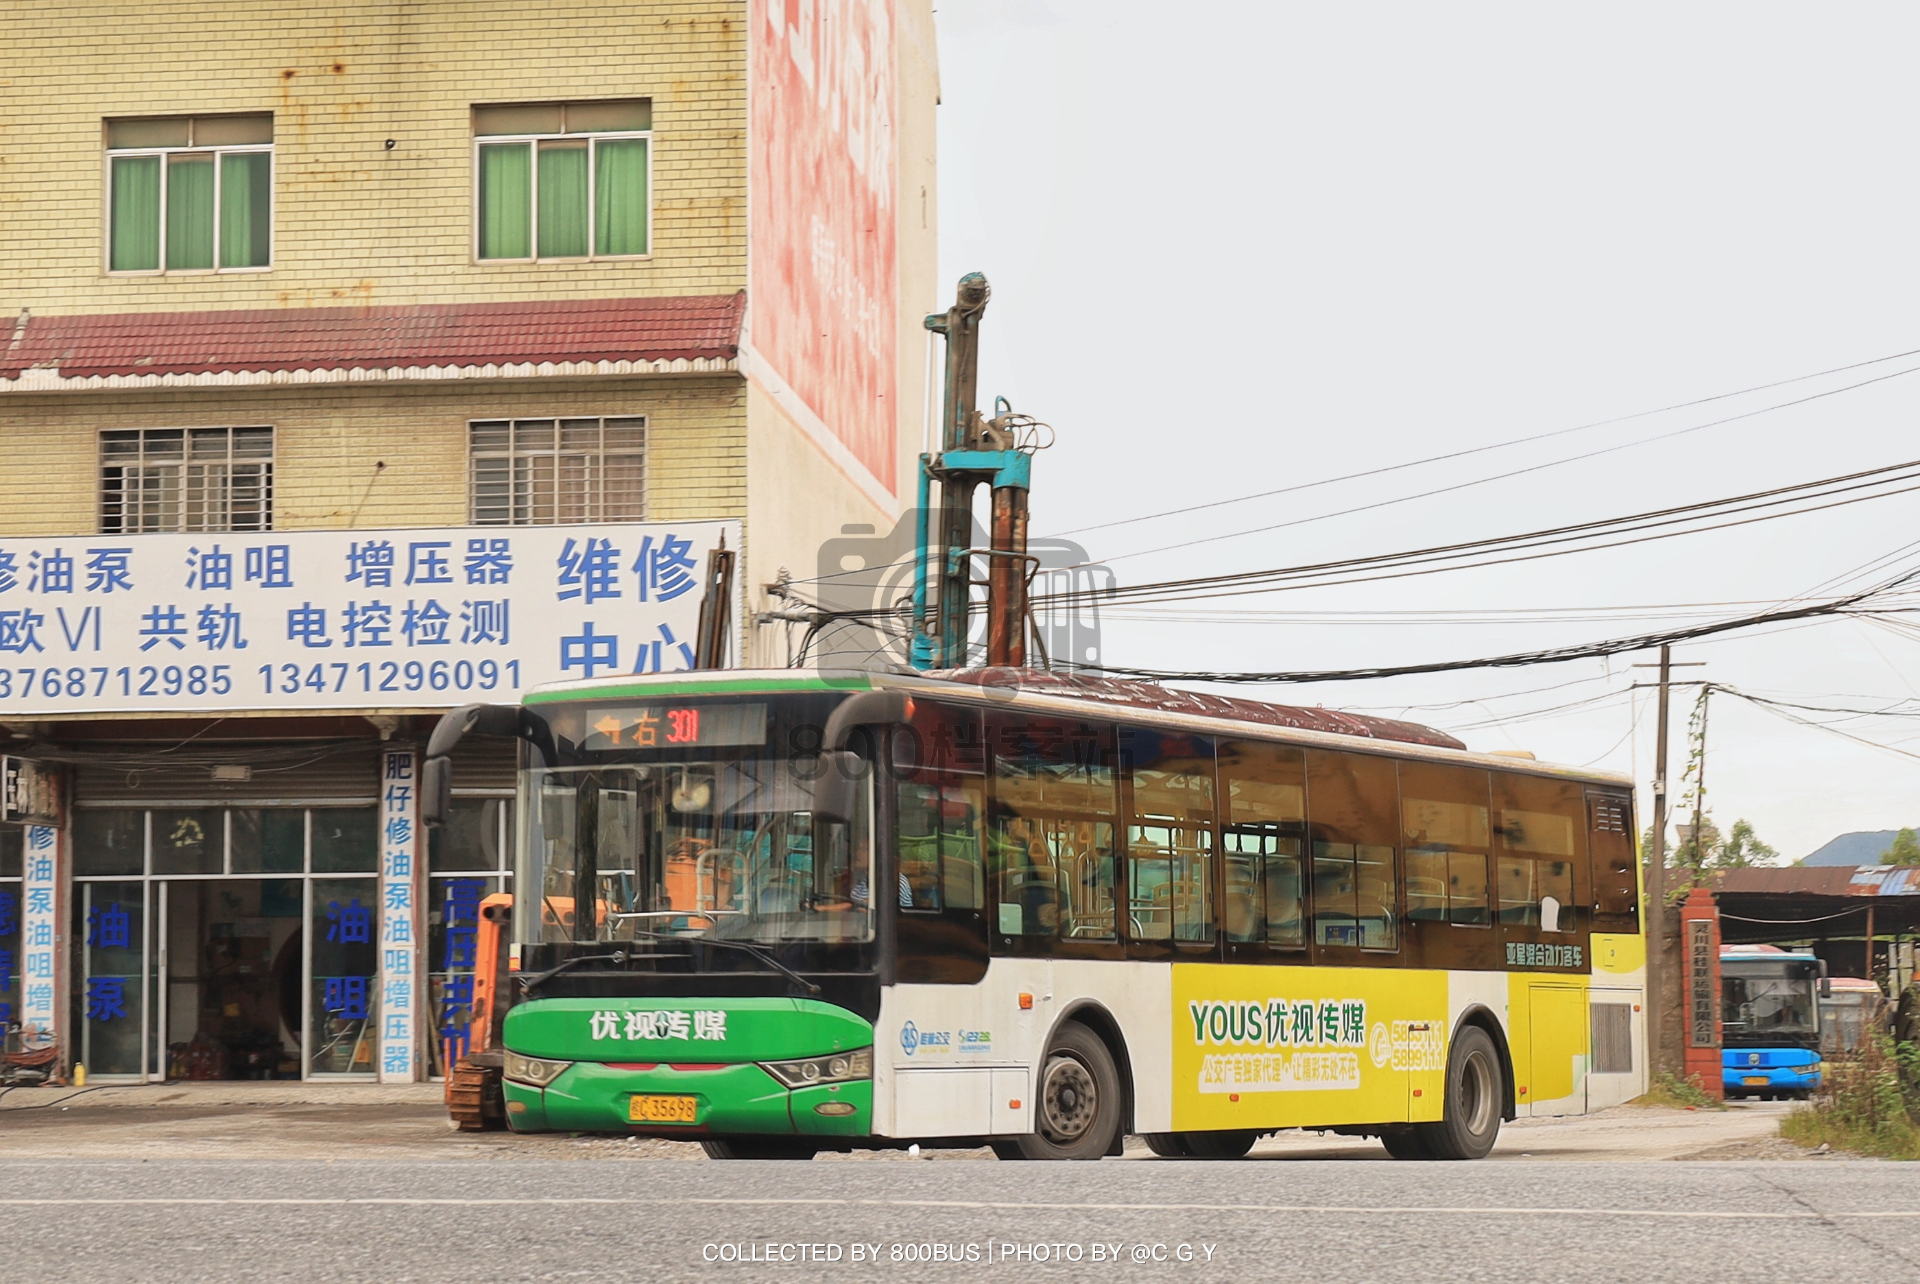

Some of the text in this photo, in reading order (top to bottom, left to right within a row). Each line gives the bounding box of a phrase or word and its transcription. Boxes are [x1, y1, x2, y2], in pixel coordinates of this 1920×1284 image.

[184, 544, 295, 591] 油咀
[344, 538, 514, 587] 增压器
[557, 534, 698, 605] 维修
[139, 602, 249, 652] 共轨
[286, 598, 511, 648] 电控检测
[560, 621, 697, 679] 中心
[259, 658, 520, 694] 13471296091
[666, 709, 699, 743] 301
[384, 753, 413, 1074] 肥仔修油泵油咀增压器
[86, 902, 131, 1021] 油泵
[325, 898, 371, 1020] 油咀
[588, 1010, 728, 1041] 优视传媒
[1190, 1002, 1364, 1044] YOUS优视传媒
